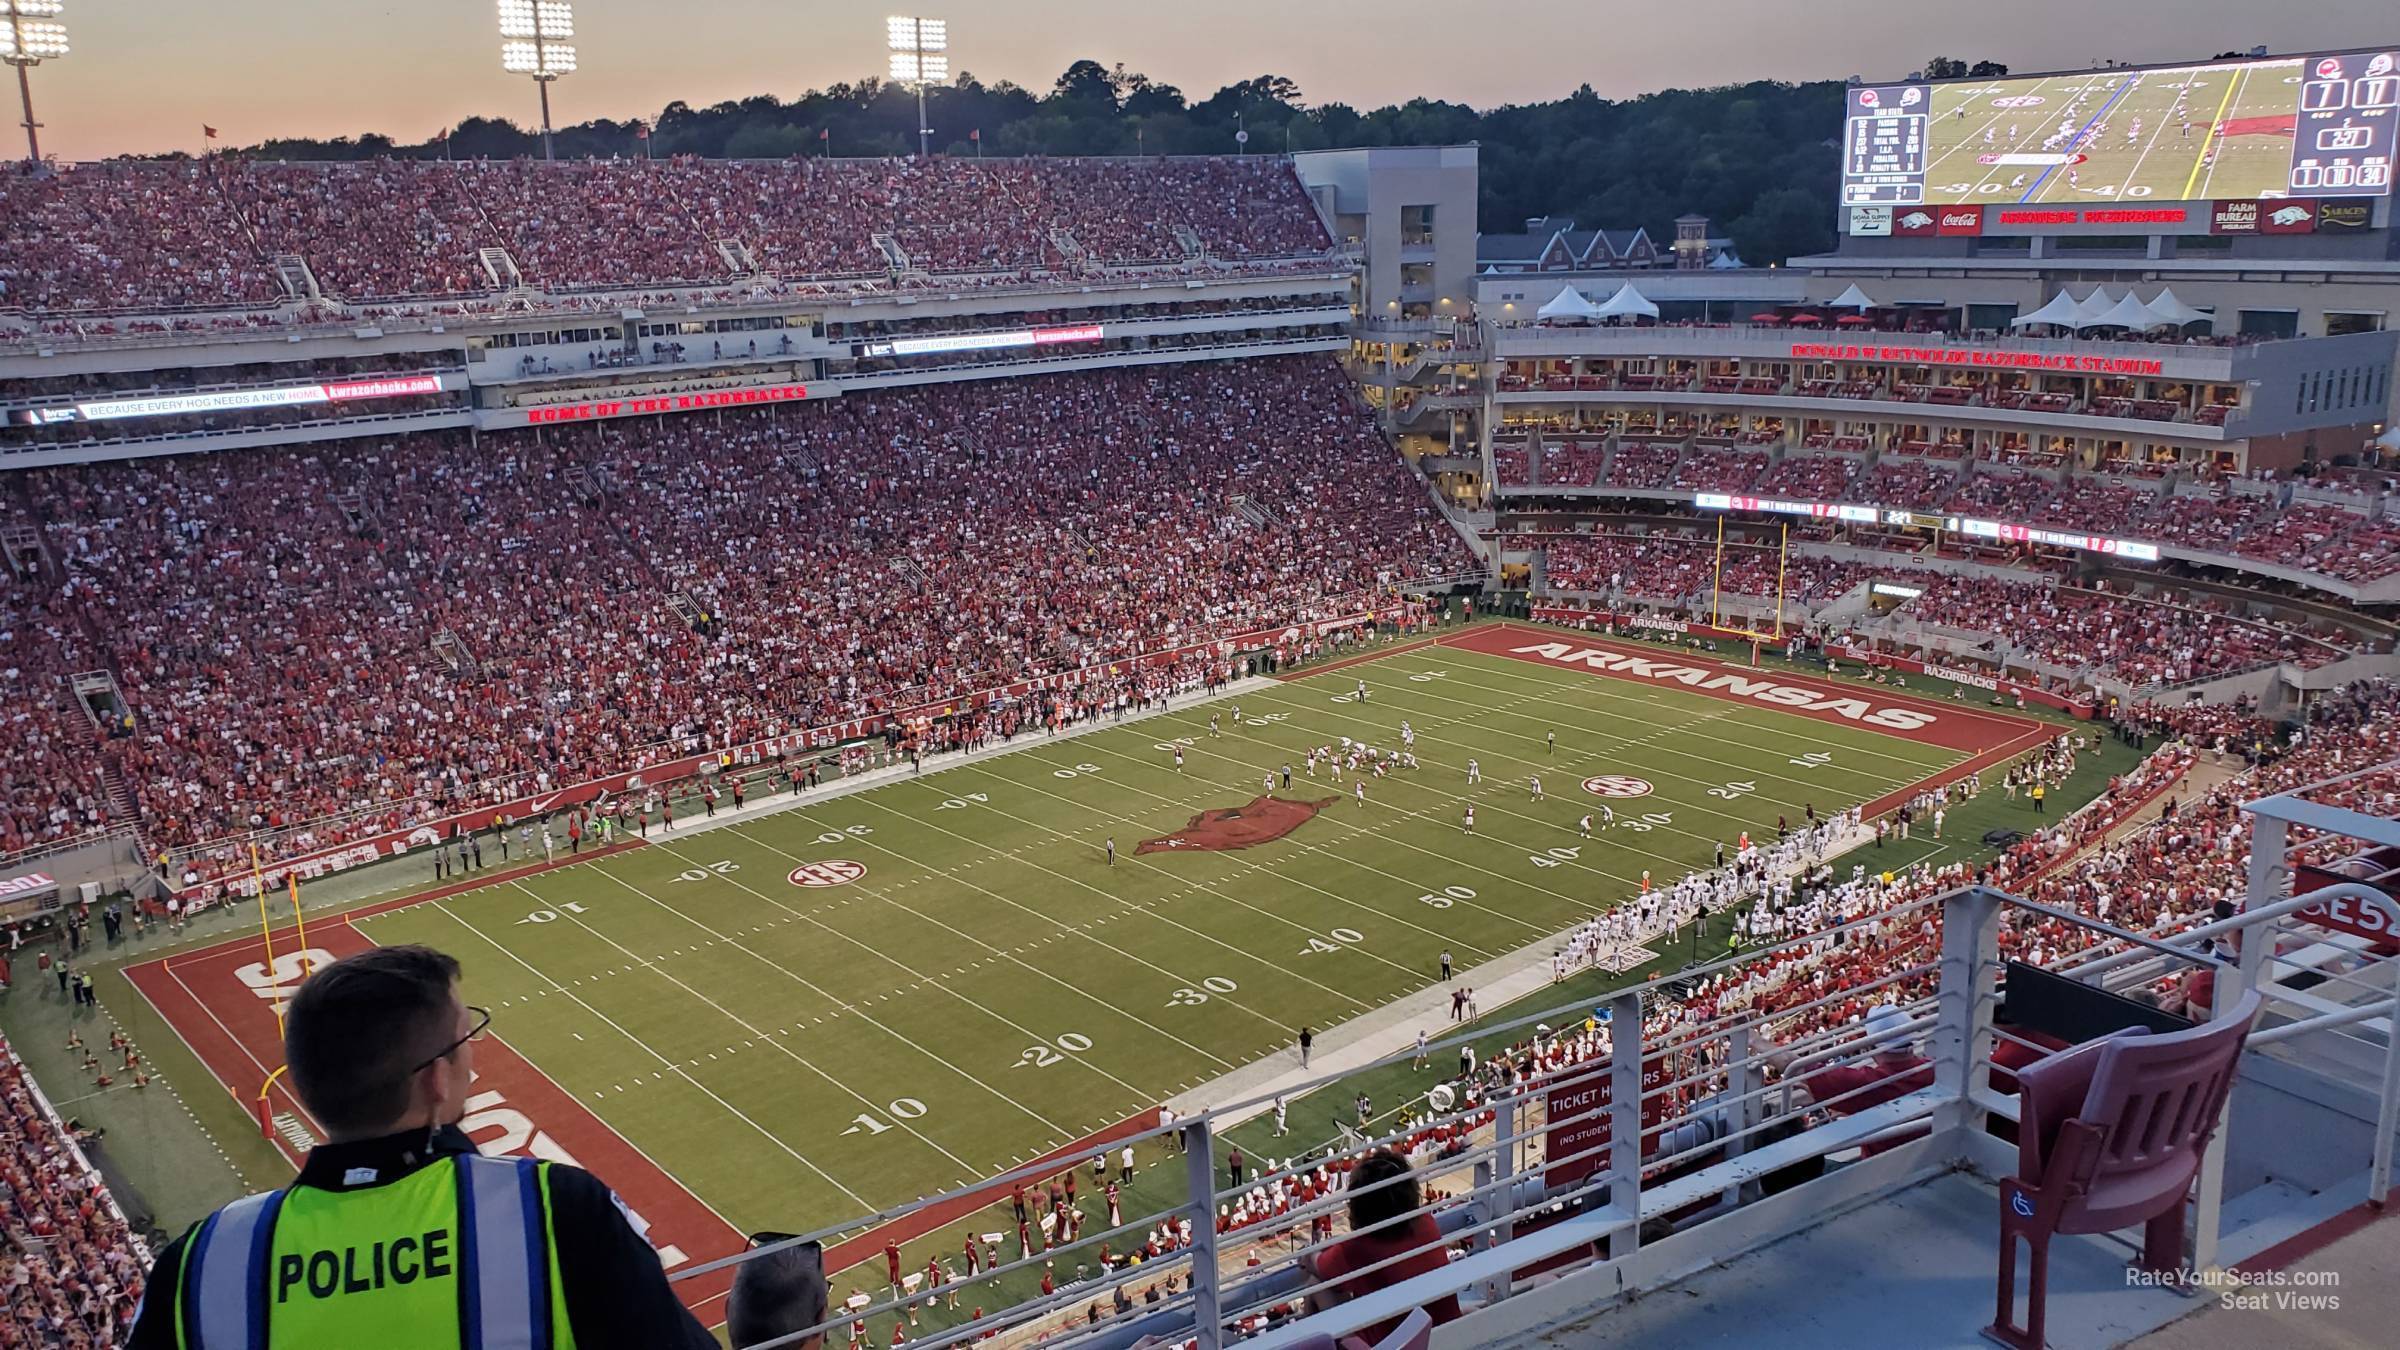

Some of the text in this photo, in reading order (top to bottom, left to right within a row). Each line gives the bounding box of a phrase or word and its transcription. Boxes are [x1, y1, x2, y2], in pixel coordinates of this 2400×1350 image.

[2320, 83, 2332, 107] 7
[2367, 80, 2386, 105] 17
[2343, 117, 2351, 128] 2
[2303, 168, 2311, 185] 1
[2333, 168, 2347, 184] 10
[2362, 167, 2381, 184] 34
[2087, 185, 2152, 197] 40
[1999, 211, 2077, 224] ARKANSAS
[2216, 213, 2256, 221] BUREAU
[2228, 203, 2256, 212] FARM
[1791, 344, 1859, 359] DONALD
[1880, 347, 1969, 364] REYNOLDS
[1972, 351, 2077, 370] RAZORBACK
[2080, 357, 2162, 375] STADIUM
[329, 381, 434, 398] kwrazorbacks.com
[90, 403, 145, 416] BECAUSE
[148, 400, 184, 412] EVERY
[187, 397, 213, 409] HOG
[213, 394, 250, 406] NEEDS
[253, 393, 260, 403] A
[262, 391, 286, 402] NEW
[289, 388, 320, 400] HOME
[528, 385, 808, 423] HOME OF THE RAZORBACKS
[1630, 617, 1688, 633] ARKANSAS
[1408, 670, 1443, 682] 10
[1508, 642, 1937, 730] ARKANSAS
[1923, 665, 1997, 691] RAZORBACKS
[1245, 713, 1289, 726] 30
[1053, 762, 1102, 779] 50
[1789, 752, 1831, 768] 10
[941, 791, 989, 810] 40
[1707, 781, 1755, 799] 20
[1620, 812, 1672, 832] 30
[816, 824, 874, 845] 30
[1529, 847, 1579, 869] 40
[680, 860, 741, 881] 20
[793, 861, 862, 887] SEC
[1419, 885, 1477, 909] 50
[528, 900, 590, 923] 10
[1308, 927, 1364, 954] 40
[1172, 976, 1238, 1006] 30
[1021, 1033, 1093, 1068] 20
[1551, 1089, 1598, 1113] TICKET
[852, 1098, 928, 1136] 10
[1560, 1134, 1575, 1147] (NO
[277, 1229, 452, 1303] POLICE
